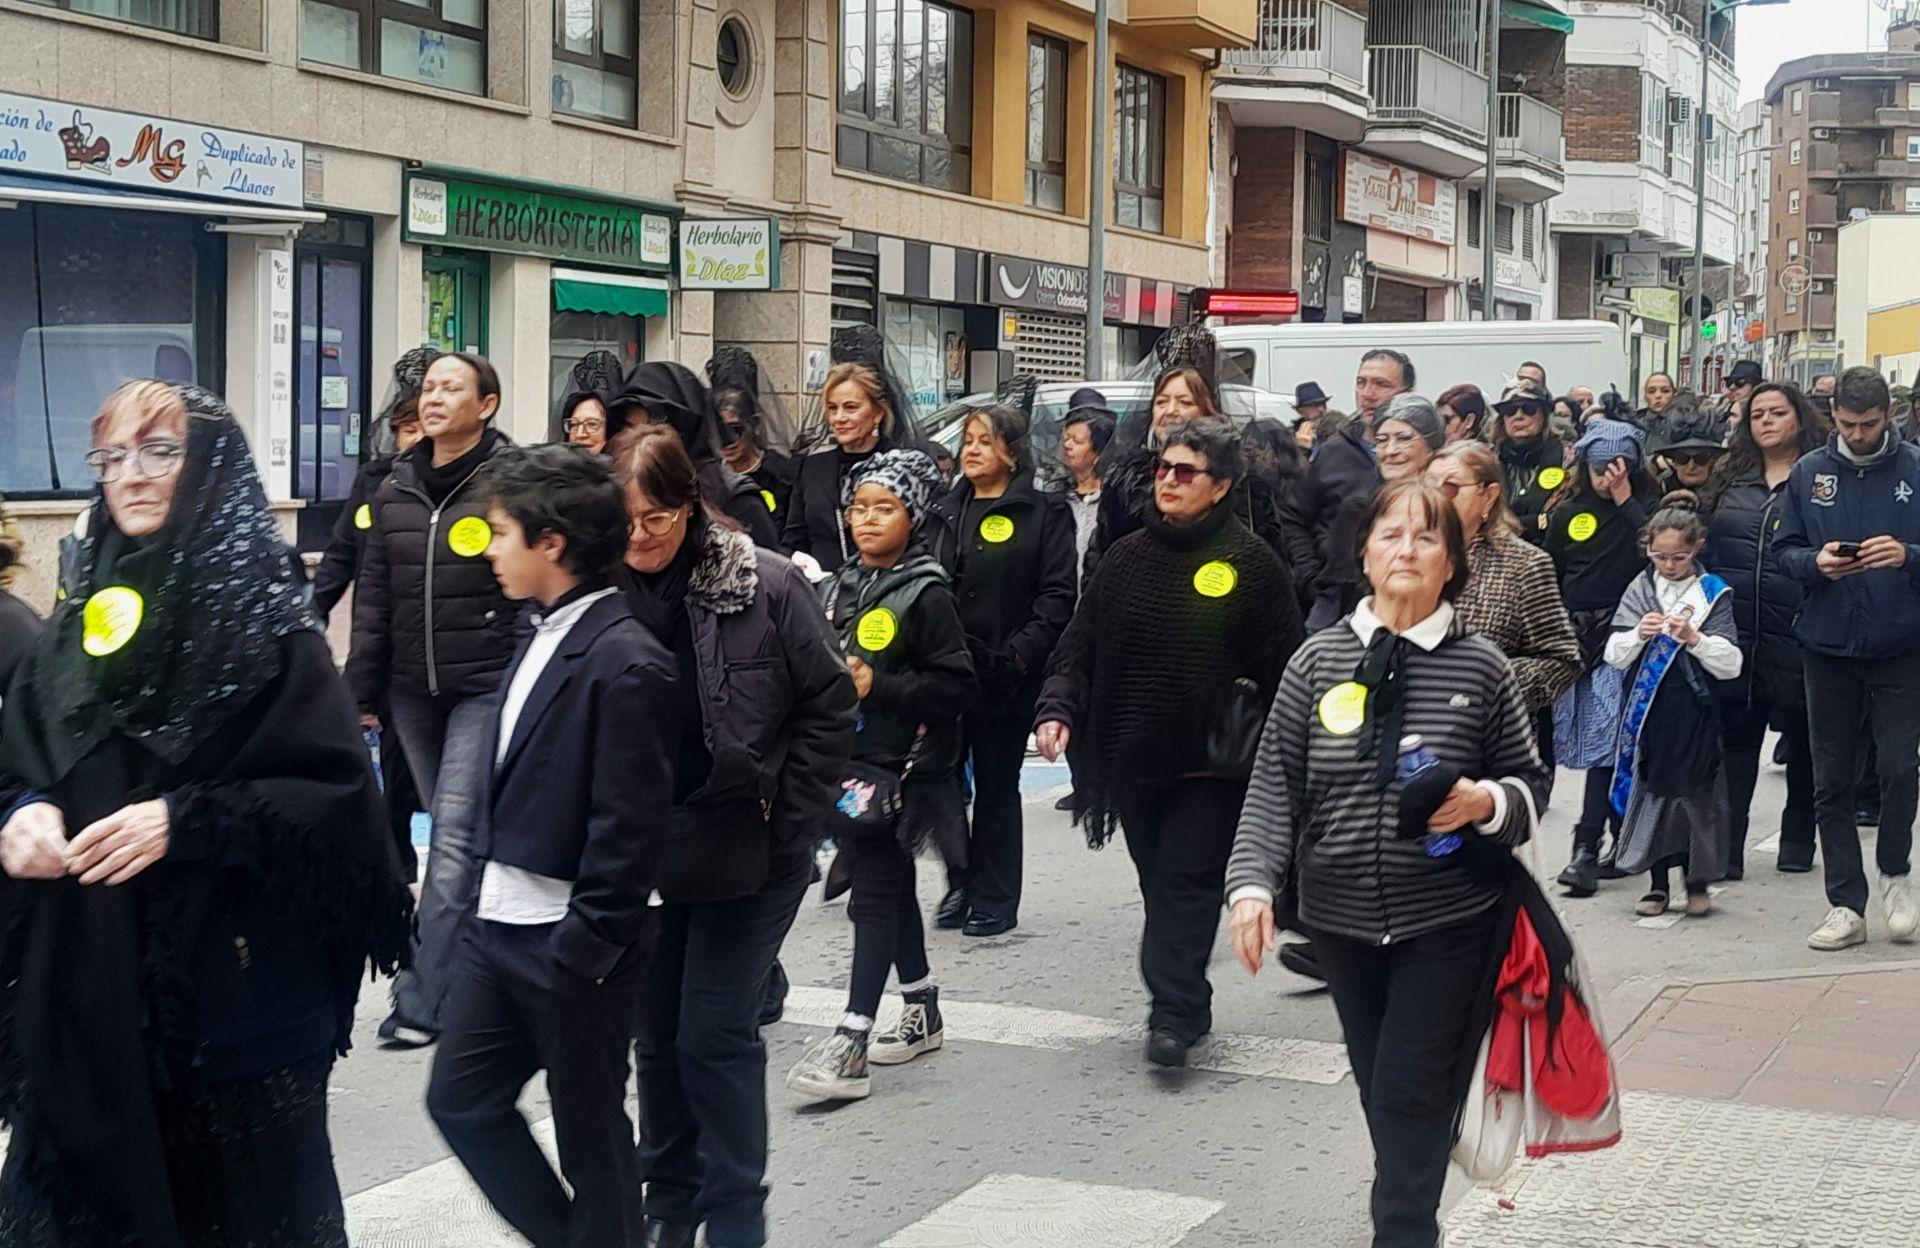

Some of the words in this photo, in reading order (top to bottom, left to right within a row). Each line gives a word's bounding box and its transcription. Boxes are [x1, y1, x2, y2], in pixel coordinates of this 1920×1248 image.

[36, 109, 53, 132] de
[201, 131, 277, 166] Duplicado
[282, 149, 296, 169] de
[222, 168, 276, 197] Llaves
[686, 224, 763, 247] Herbolario
[698, 256, 750, 284] Díaz
[1036, 264, 1120, 299] VISIONDEAL
